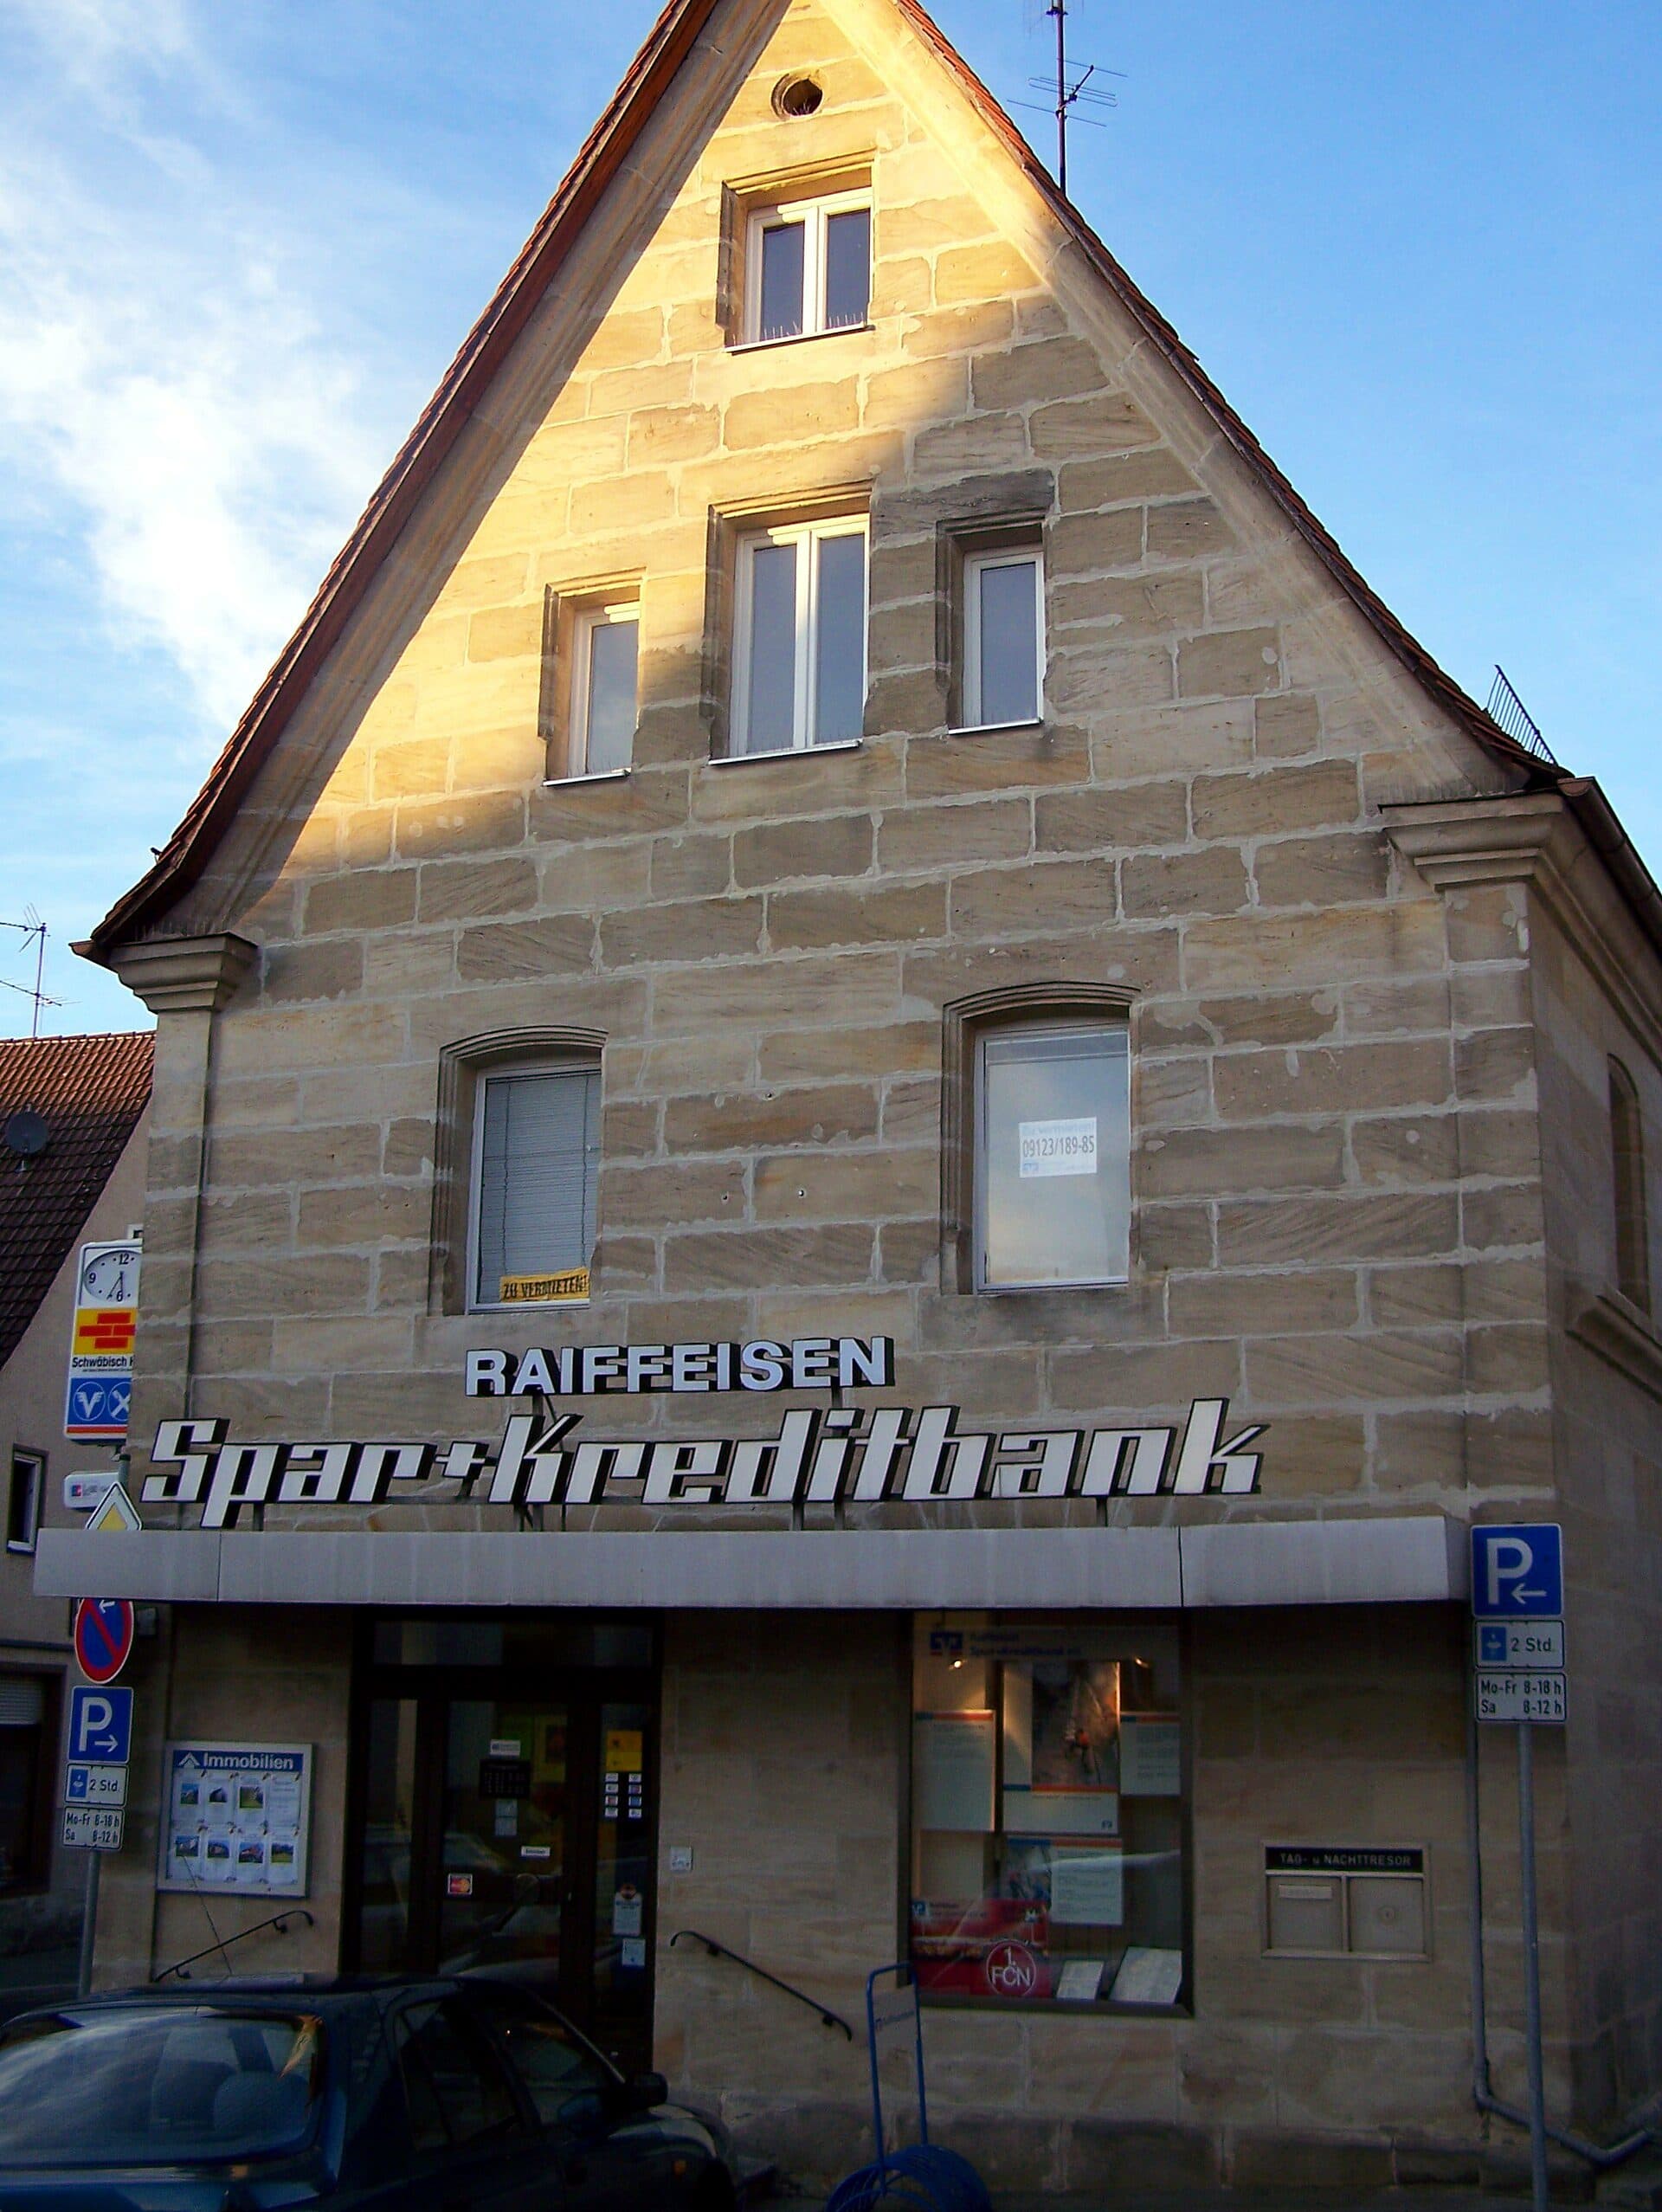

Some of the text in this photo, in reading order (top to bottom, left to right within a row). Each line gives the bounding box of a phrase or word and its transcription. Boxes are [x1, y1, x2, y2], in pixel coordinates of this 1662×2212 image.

[119, 1253, 130, 1265] 12
[88, 1273, 96, 1284] 9
[72, 1356, 127, 1368] Schwäbisch
[466, 1337, 897, 1396] RAIFFEISEN
[1486, 1537, 1533, 1605] P
[1511, 1637, 1519, 1651] 2
[1481, 1680, 1561, 1694] Mo-Fr 8-18 h
[1481, 1700, 1562, 1713] Sa 8-12 h
[78, 1697, 113, 1752] P
[203, 1752, 293, 1770] Immobilien
[89, 1778, 96, 1790] 2
[67, 1812, 119, 1827] Mo-Fr 8-18 h
[66, 1828, 118, 1843] Sa 8-12 h
[991, 1966, 1031, 1987] FCN
